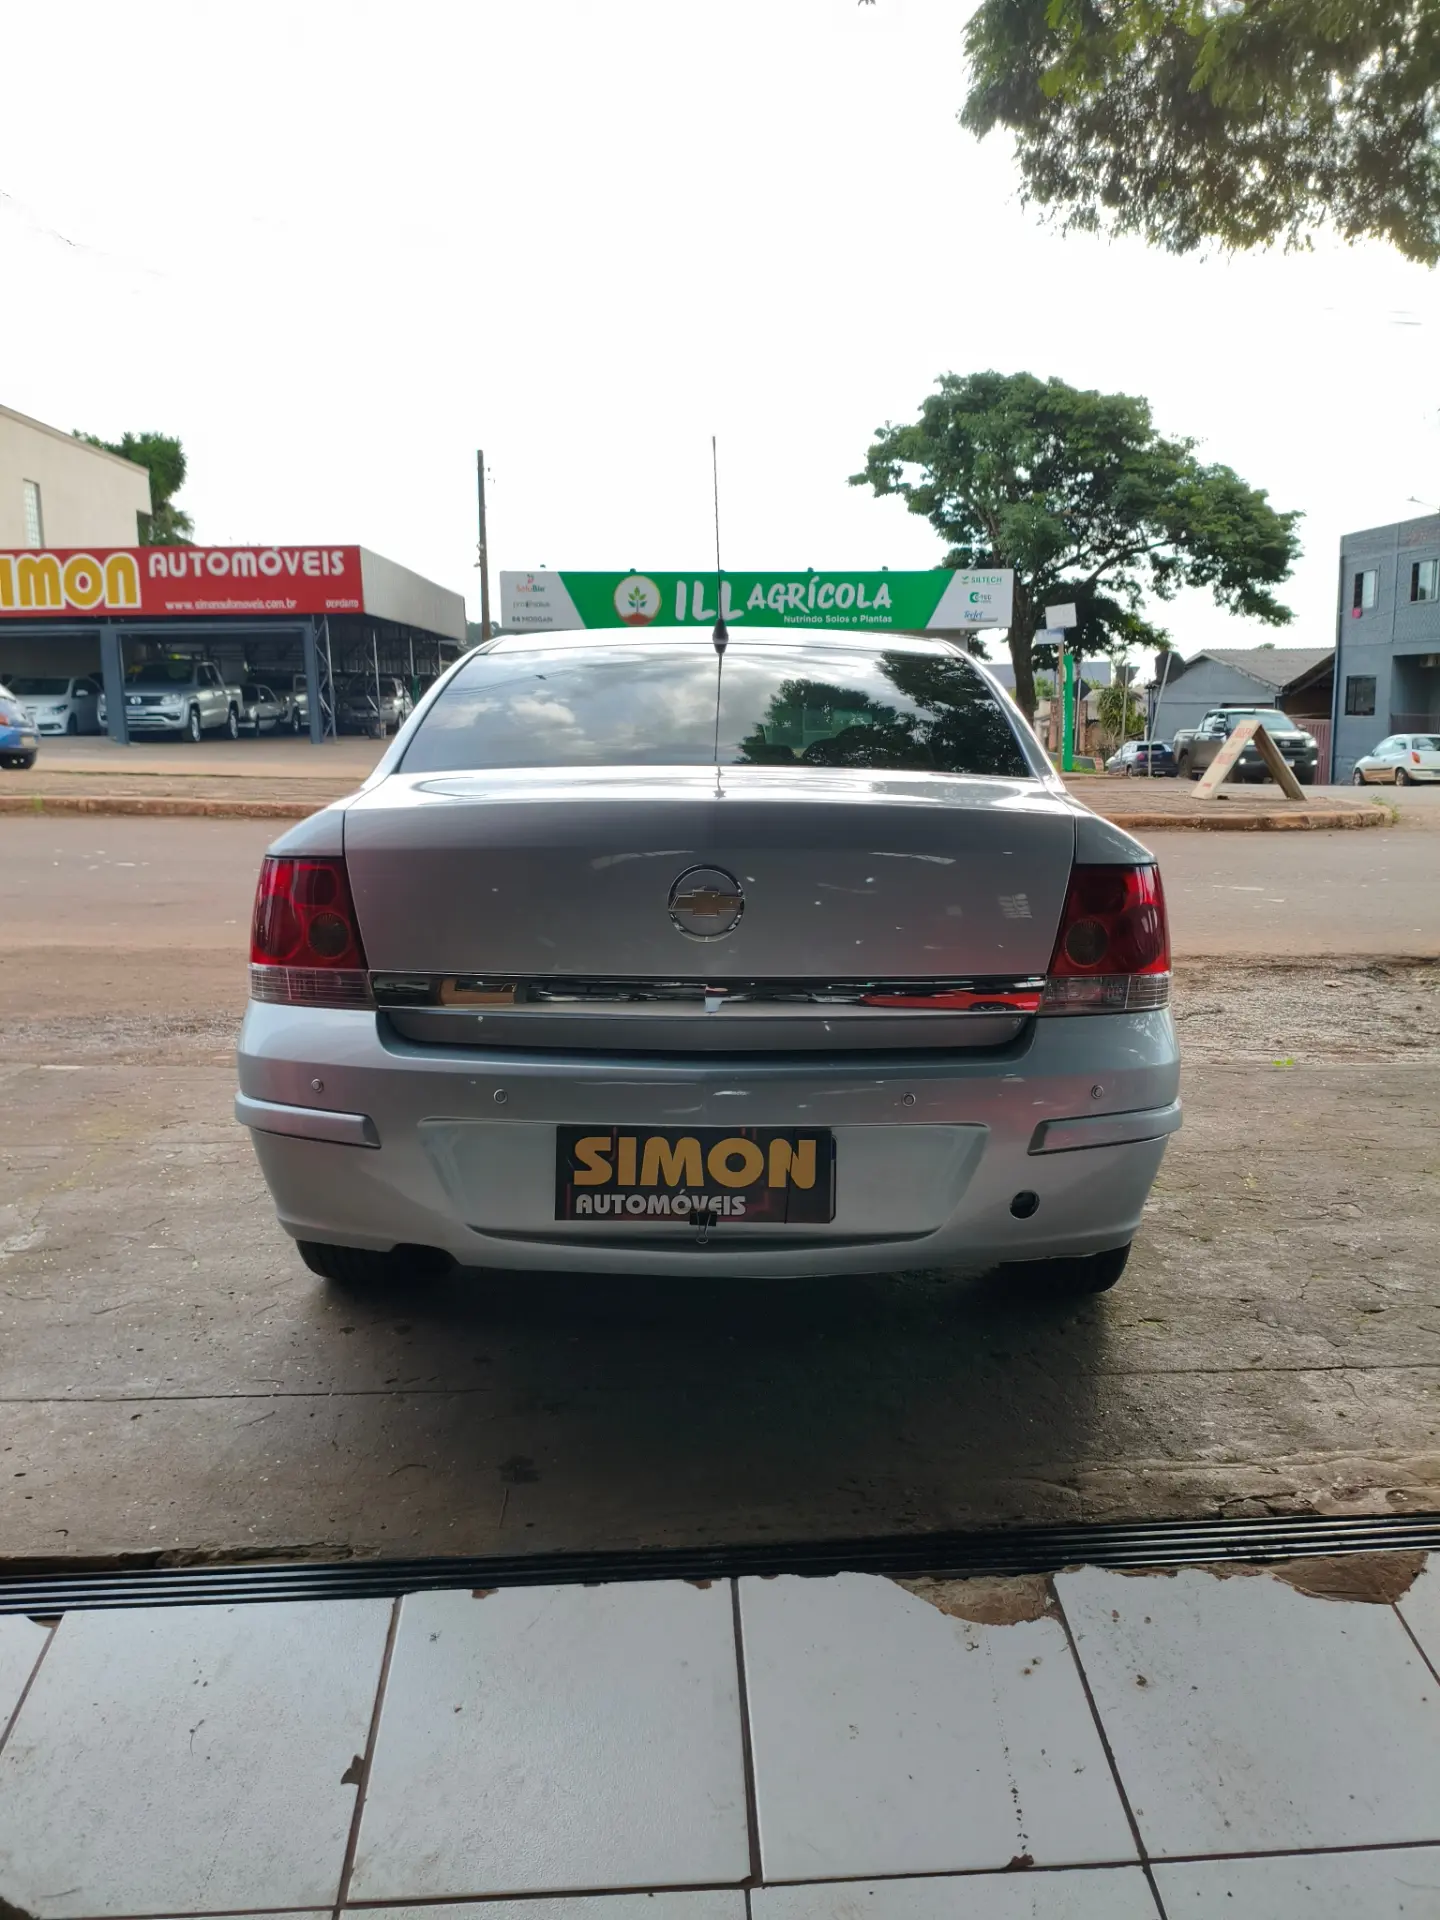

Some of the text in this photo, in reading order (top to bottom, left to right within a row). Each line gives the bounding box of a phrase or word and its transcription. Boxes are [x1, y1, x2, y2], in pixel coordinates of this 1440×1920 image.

[148, 546, 345, 579] AUTOMÓVEIS
[675, 575, 893, 621] ILL AGRÍCOLA
[784, 614, 823, 623] Nutrindo
[826, 614, 850, 623] Solos
[860, 614, 892, 623] Plantas
[573, 1136, 817, 1190] SIMON
[575, 1189, 747, 1216] AUTOMÓVEIS
